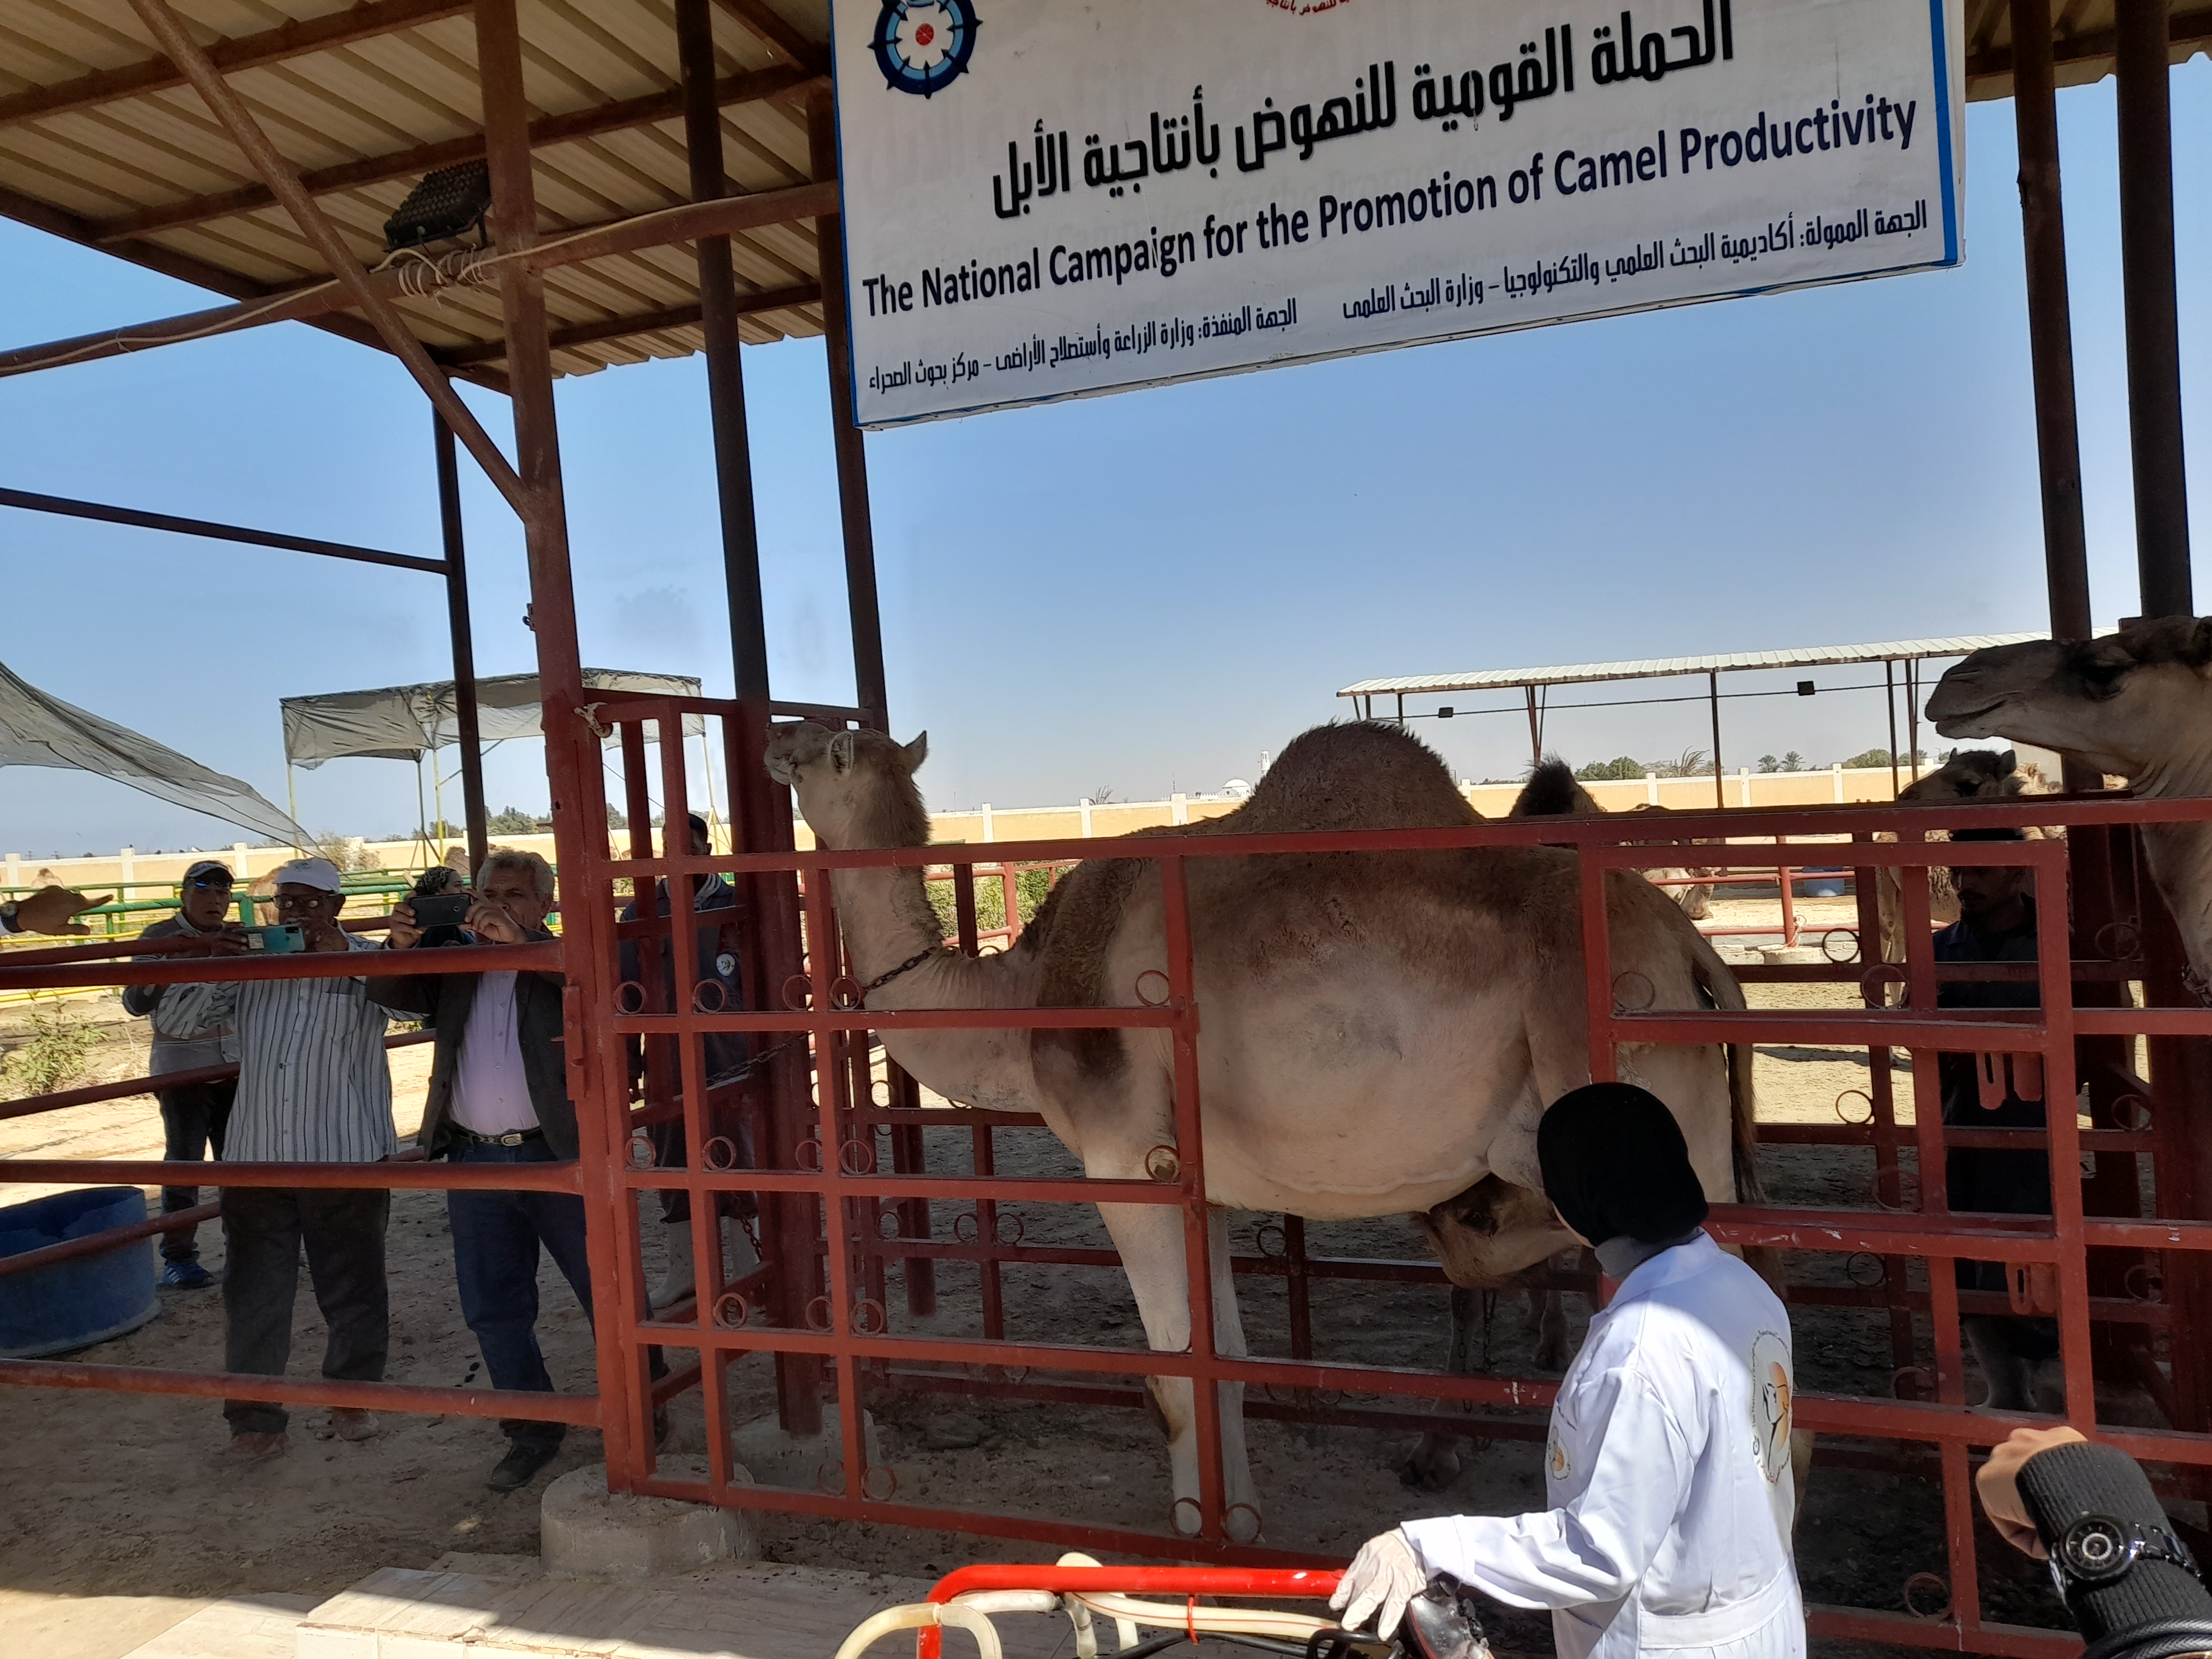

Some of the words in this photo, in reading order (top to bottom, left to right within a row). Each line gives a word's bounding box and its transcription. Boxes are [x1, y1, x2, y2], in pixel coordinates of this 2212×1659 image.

[1592, 0, 1733, 85] الحملة
[1412, 24, 1574, 132] القومية
[1235, 60, 1397, 173] للنهوض
[1083, 85, 1221, 198] بأنتاجية
[993, 118, 1071, 220] الأبل
[862, 273, 913, 317] The
[922, 247, 1040, 308] National
[1049, 226, 1196, 286] Campaign
[1203, 214, 1248, 259] for
[1256, 202, 1309, 249] the
[1319, 170, 1497, 238] Promotion
[1508, 152, 1543, 204] of
[1554, 129, 1667, 195] Camel
[1679, 93, 1917, 174] Productivity
[1874, 199, 1927, 238] الجهة
[1670, 232, 1715, 269] البحث
[1721, 211, 1794, 264] أكاديمية
[1504, 252, 1600, 299] والتكنولوجيا
[1605, 240, 1665, 283] العلمي
[1400, 277, 1441, 312] البحث
[1445, 273, 1484, 307] وزارة
[1160, 317, 1194, 350] وزارة
[1256, 297, 1297, 332] الجهة
[1050, 322, 1110, 368] وأستصلاح
[1114, 320, 1156, 354] الزراعة
[869, 361, 911, 395] الصحراء
[915, 358, 947, 387] بحوث
[951, 352, 979, 384] مركز
